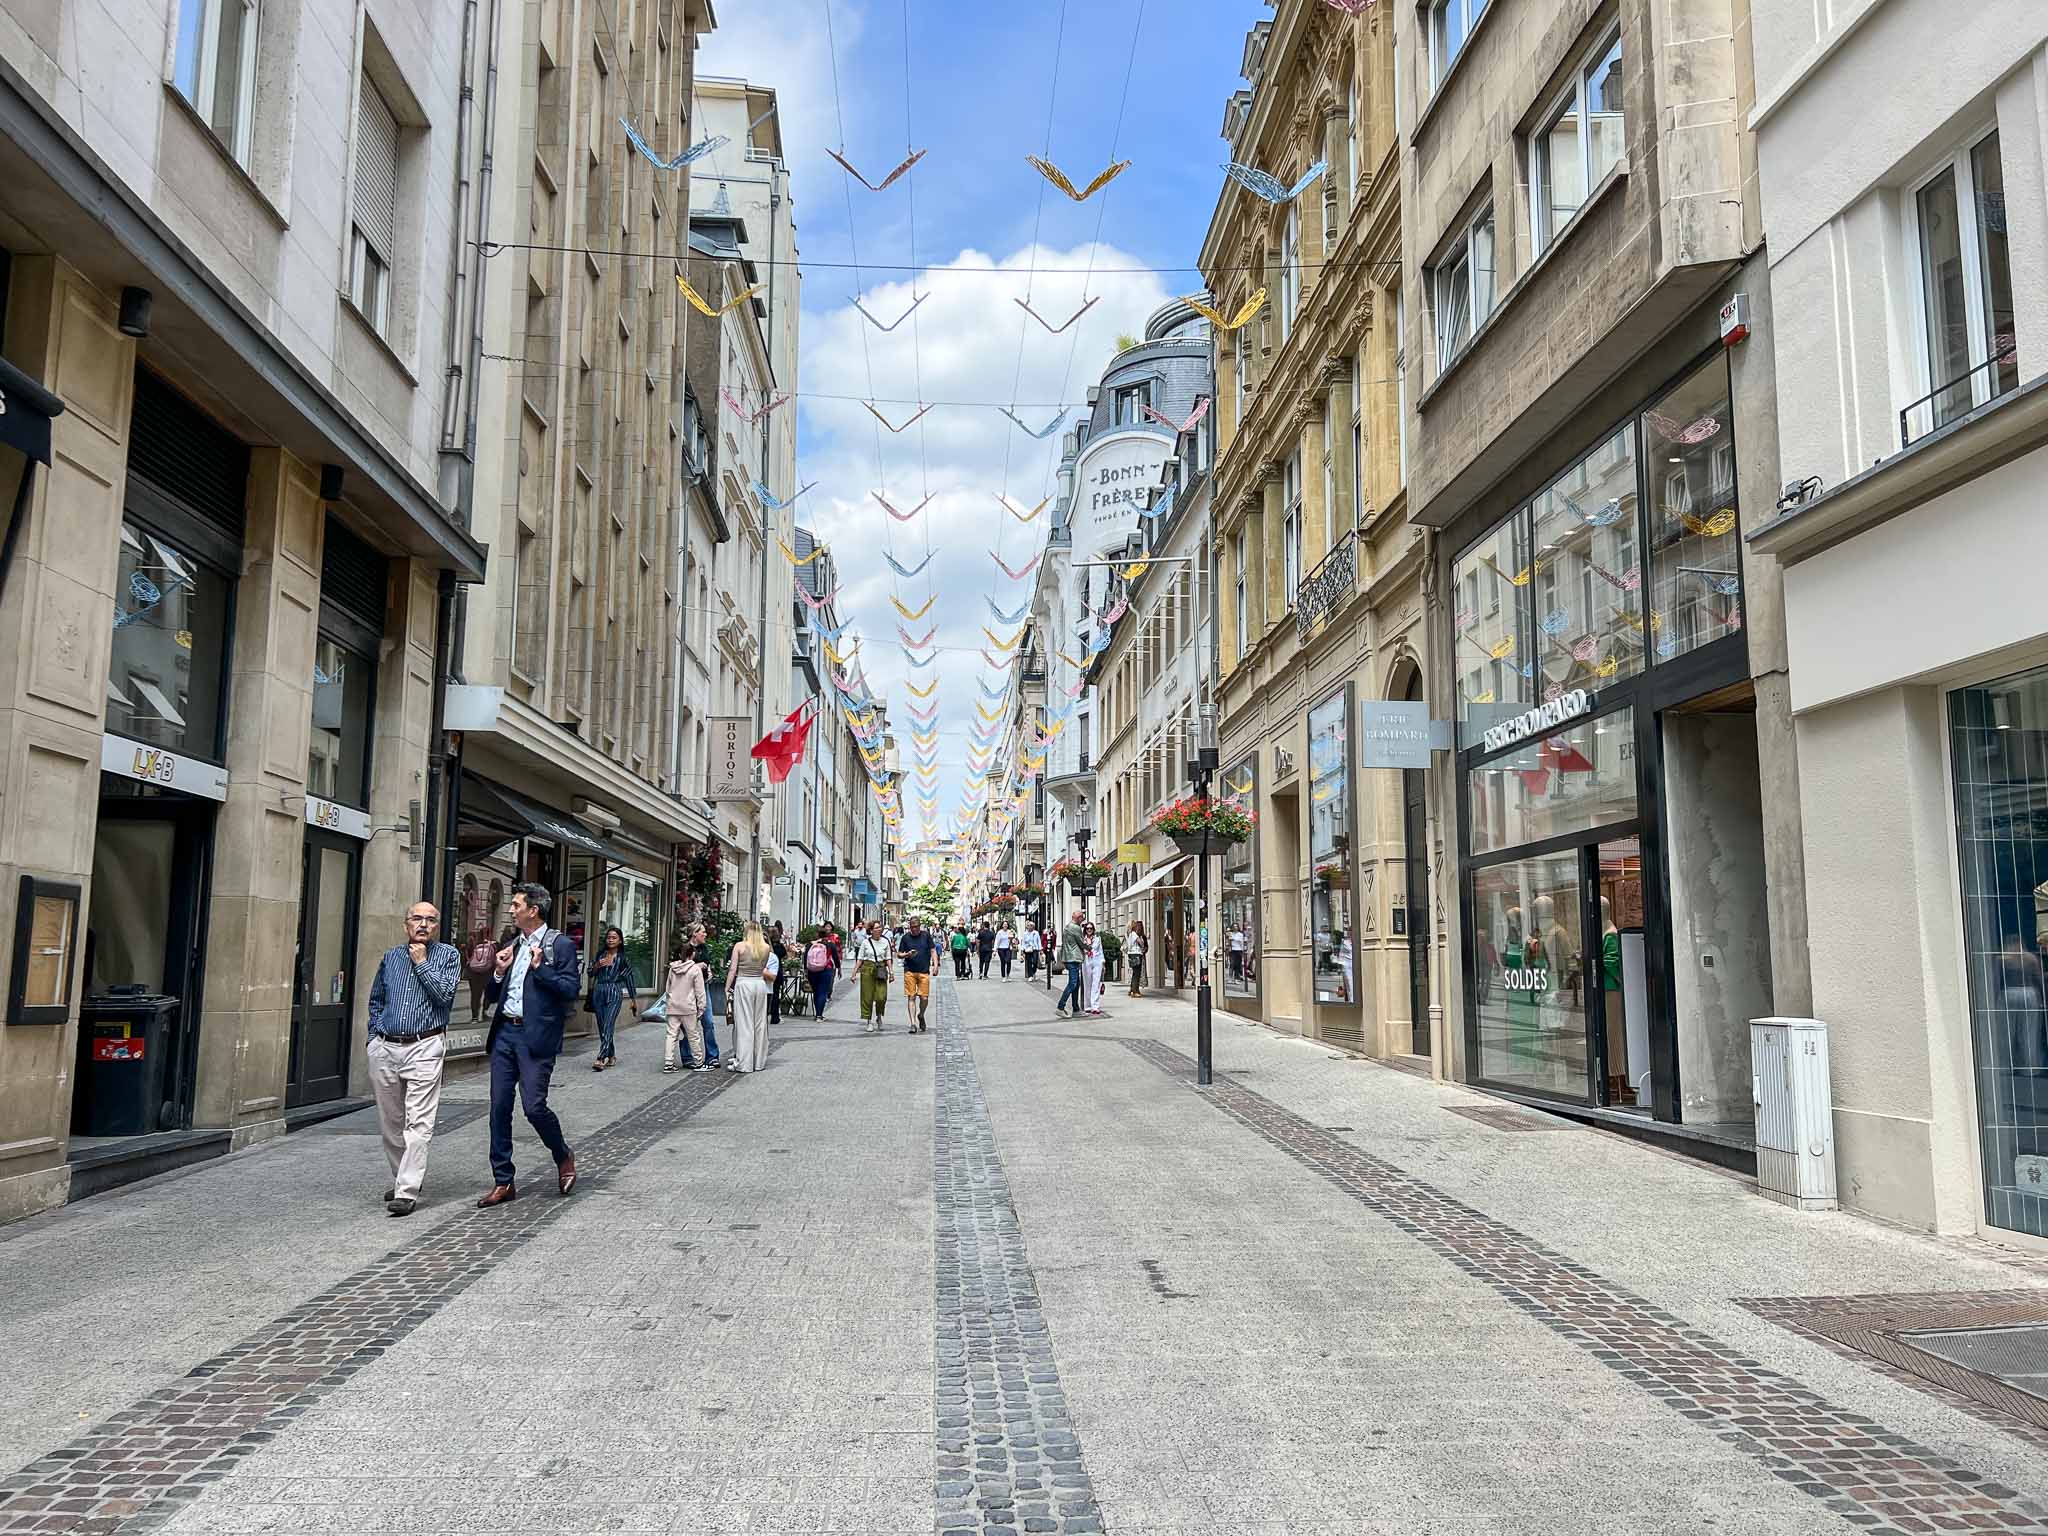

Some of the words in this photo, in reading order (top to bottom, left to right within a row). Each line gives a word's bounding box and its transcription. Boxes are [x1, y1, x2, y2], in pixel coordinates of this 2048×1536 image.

[1100, 464, 1145, 485] BONN
[1092, 487, 1149, 510] FRÈRE
[1484, 719, 1516, 753] ERIC
[726, 722, 737, 780] HORTOS
[713, 782, 746, 796] Fleurs
[1504, 968, 1548, 991] SOLDES
